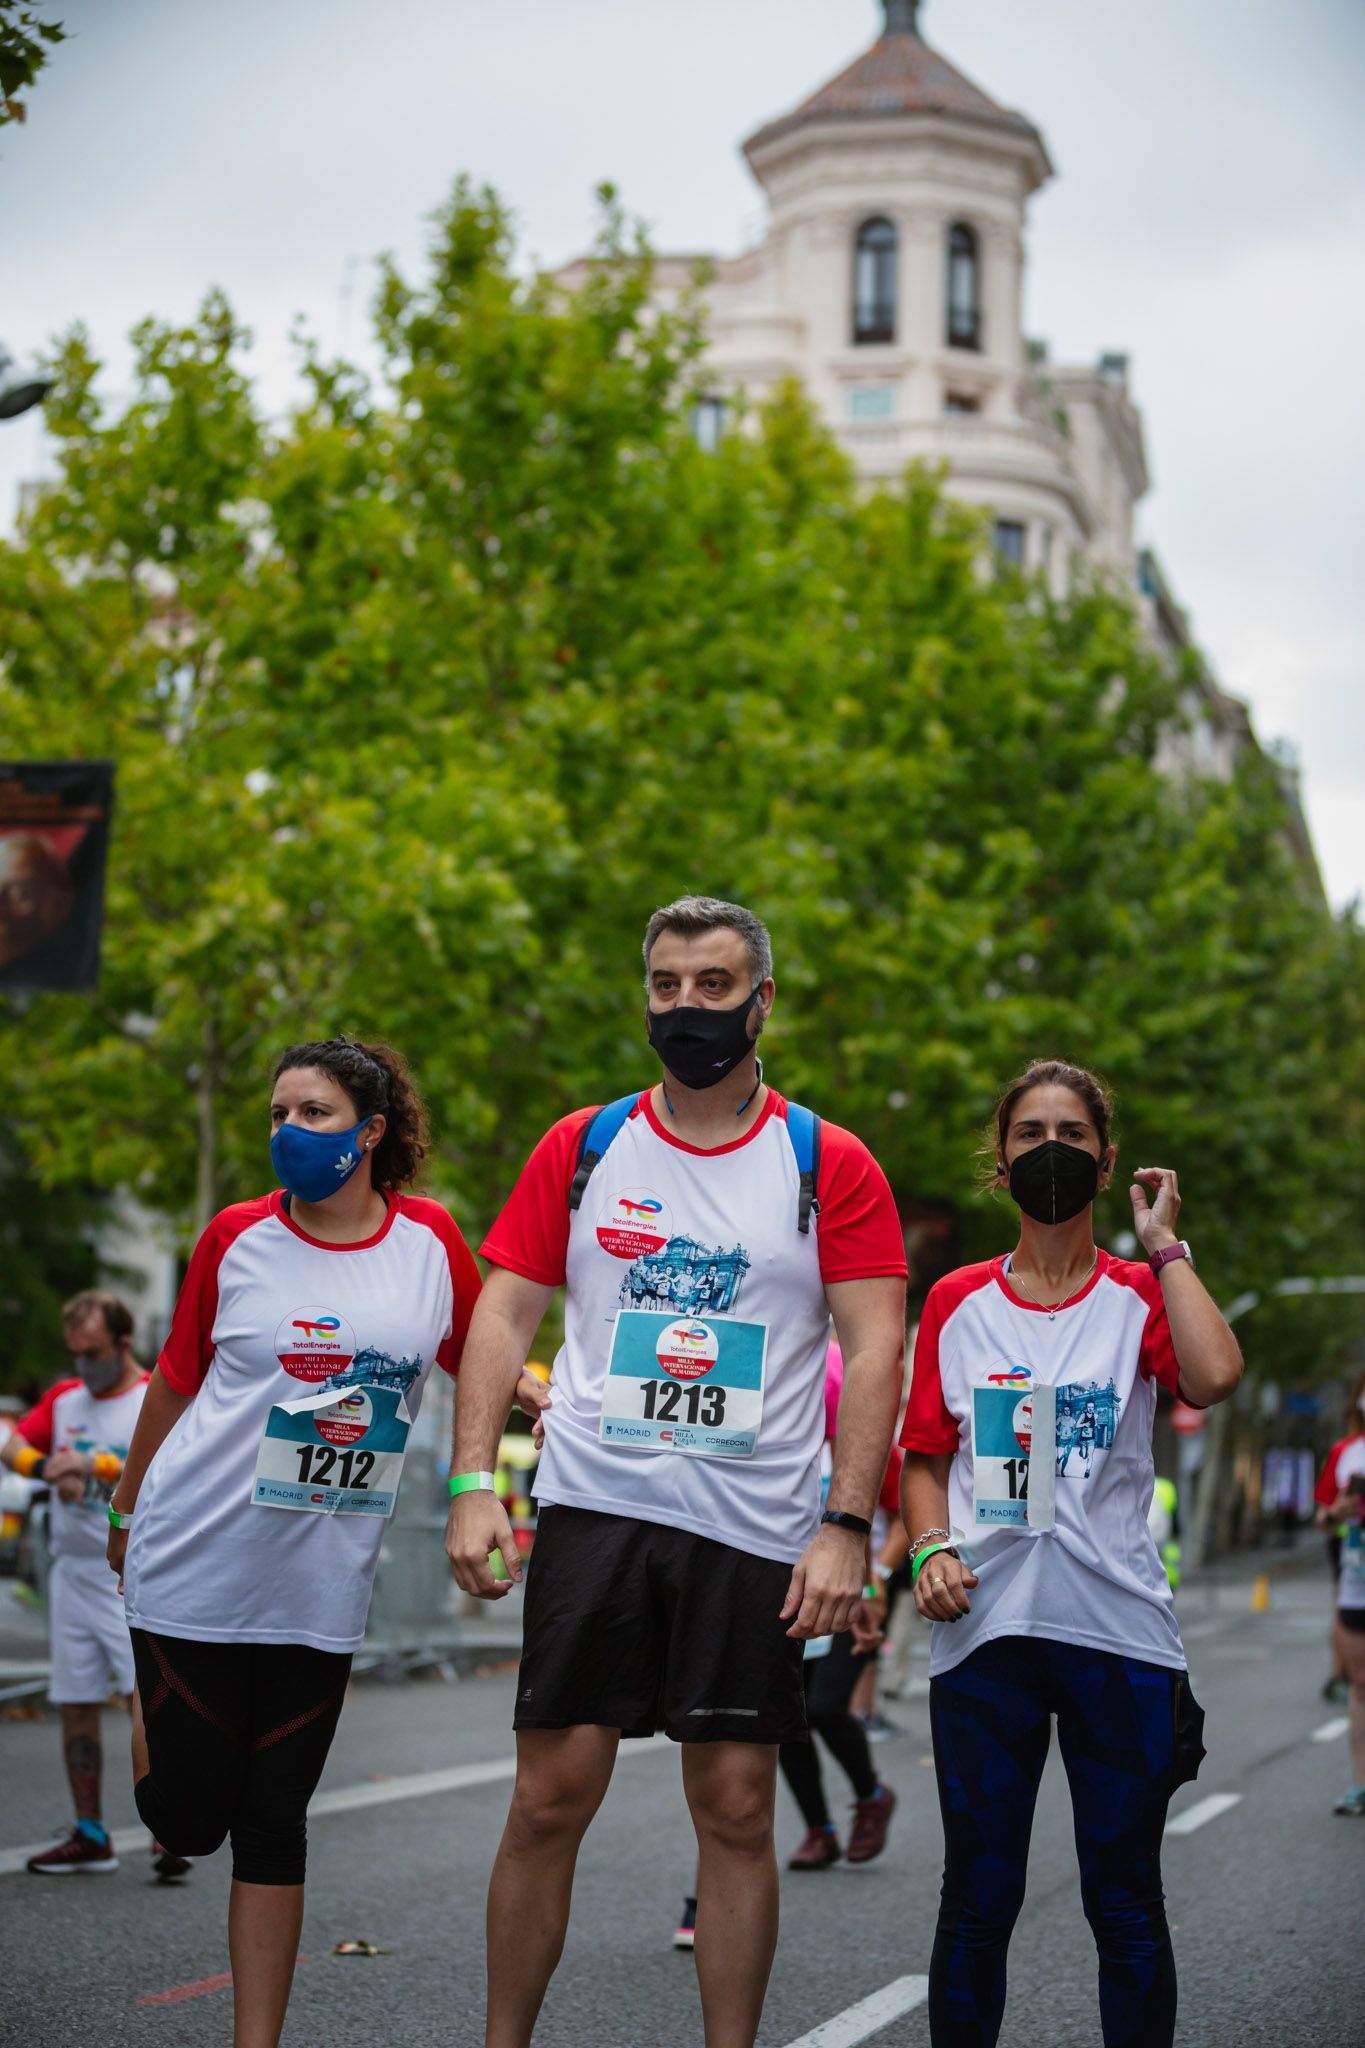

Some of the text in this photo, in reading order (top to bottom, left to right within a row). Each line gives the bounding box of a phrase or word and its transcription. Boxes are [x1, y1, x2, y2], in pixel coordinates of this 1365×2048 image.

[611, 1216, 657, 1231] TotalEnergies
[618, 1231, 640, 1241] MILLA
[601, 1236, 655, 1250] INTERNACIONAL
[618, 1244, 646, 1255] MADRID
[292, 1341, 341, 1350] TotalEnergies
[670, 1346, 707, 1355] TotalEnergies
[677, 1357, 695, 1365] MILLA
[663, 1362, 708, 1372] INTERNACIONAL
[678, 1369, 701, 1377] MADRID
[640, 1380, 726, 1427] 1213
[327, 1411, 361, 1421] TotalEnergies
[320, 1427, 361, 1437] INTERNACIONAL
[616, 1426, 651, 1438] MADRID
[334, 1434, 355, 1442] MADRID
[296, 1444, 375, 1489] 1212
[269, 1488, 303, 1500] MADRID
[990, 1509, 1019, 1517] MADRID
